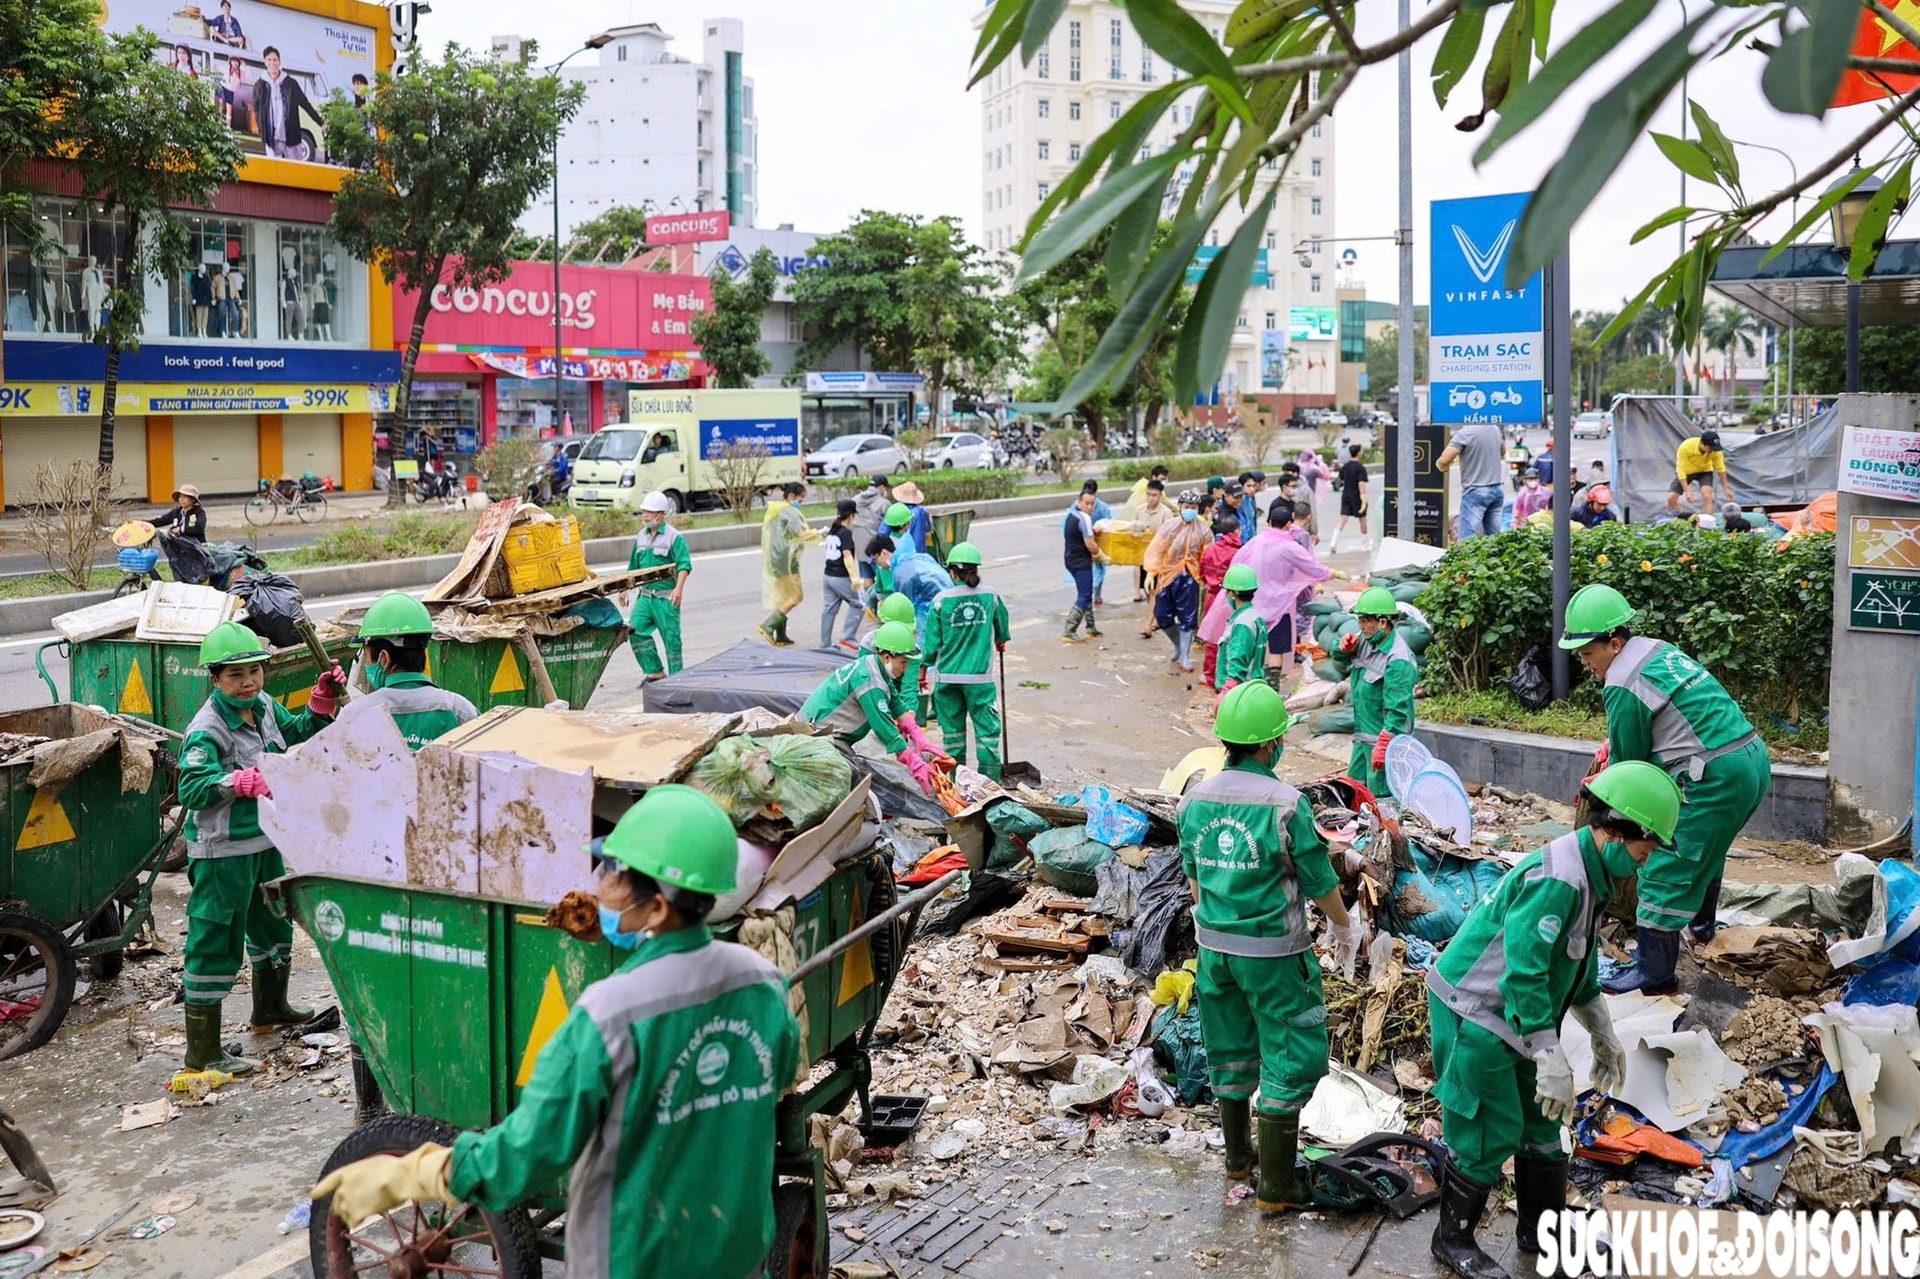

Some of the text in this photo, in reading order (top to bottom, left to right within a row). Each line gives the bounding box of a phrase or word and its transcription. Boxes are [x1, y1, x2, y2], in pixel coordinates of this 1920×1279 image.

[1445, 289, 1526, 302] VINFAST
[651, 320, 660, 333] &
[664, 320, 686, 334] Em
[1441, 343, 1531, 360] TRẠM SẠC
[164, 356, 190, 367] look
[194, 356, 223, 370] good
[232, 356, 254, 367] feel
[256, 358, 285, 370] good
[1440, 363, 1532, 373] CHARGING STATION
[187, 388, 210, 396] MUA
[212, 388, 218, 396] 2
[302, 389, 349, 406] 399K
[257, 400, 281, 409] YODY
[1491, 415, 1502, 423] B1
[1201, 825, 1210, 834] TY
[1210, 818, 1219, 829] CỔ
[1220, 815, 1236, 826] PHẦN
[676, 1048, 691, 1067] TY
[688, 1027, 702, 1051] CỔ
[702, 1015, 727, 1038] PHẦN
[727, 1019, 751, 1037] MÔI
[722, 1085, 739, 1104] ĐÔ
